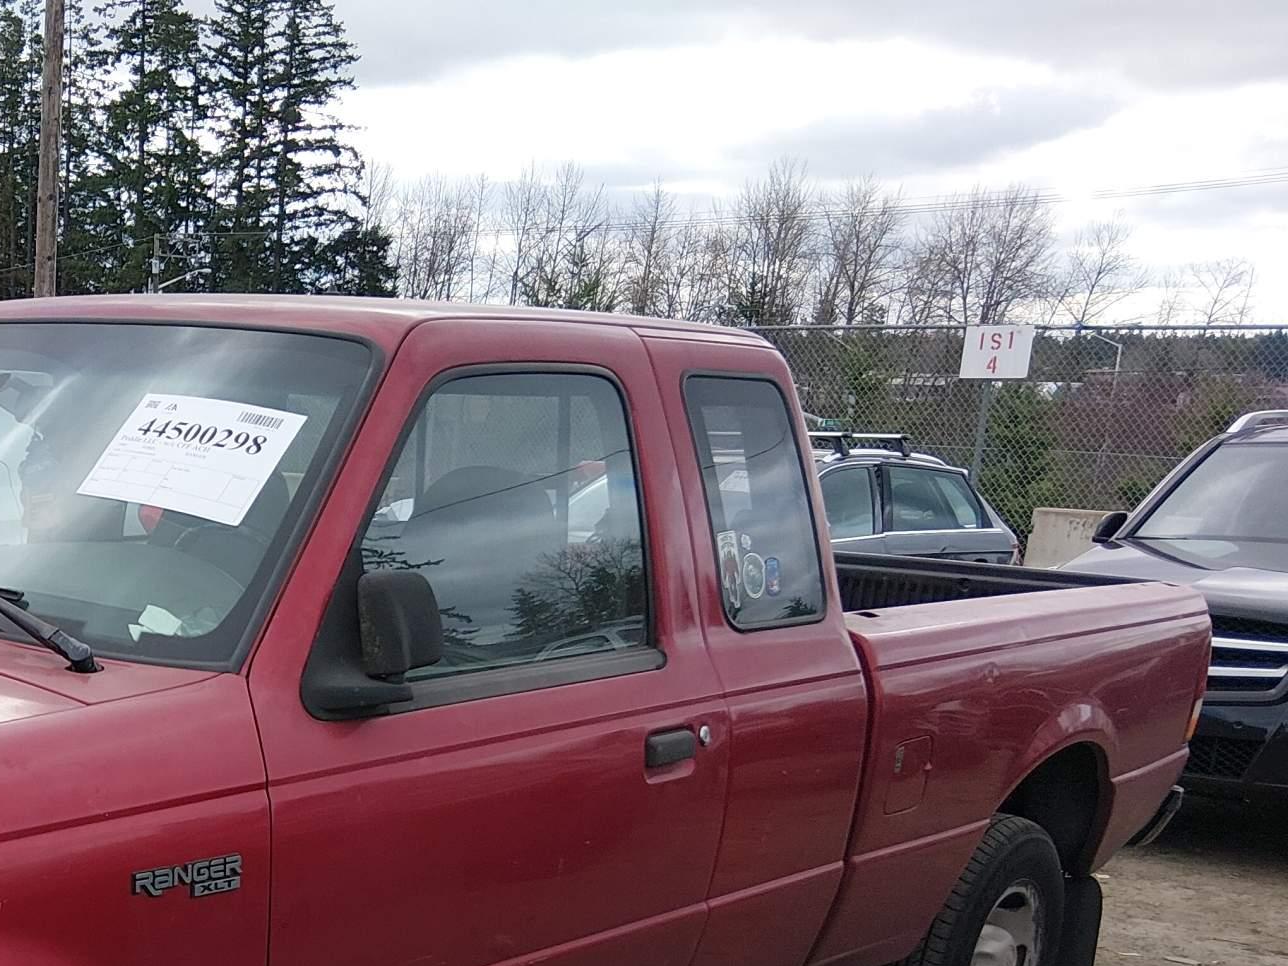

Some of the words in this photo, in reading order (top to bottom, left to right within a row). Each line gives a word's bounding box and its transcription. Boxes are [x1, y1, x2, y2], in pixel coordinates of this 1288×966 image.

[985, 355, 997, 374] 4
[137, 417, 268, 456] 44500298
[132, 853, 243, 896] RANGER
[200, 878, 236, 894] XLT
